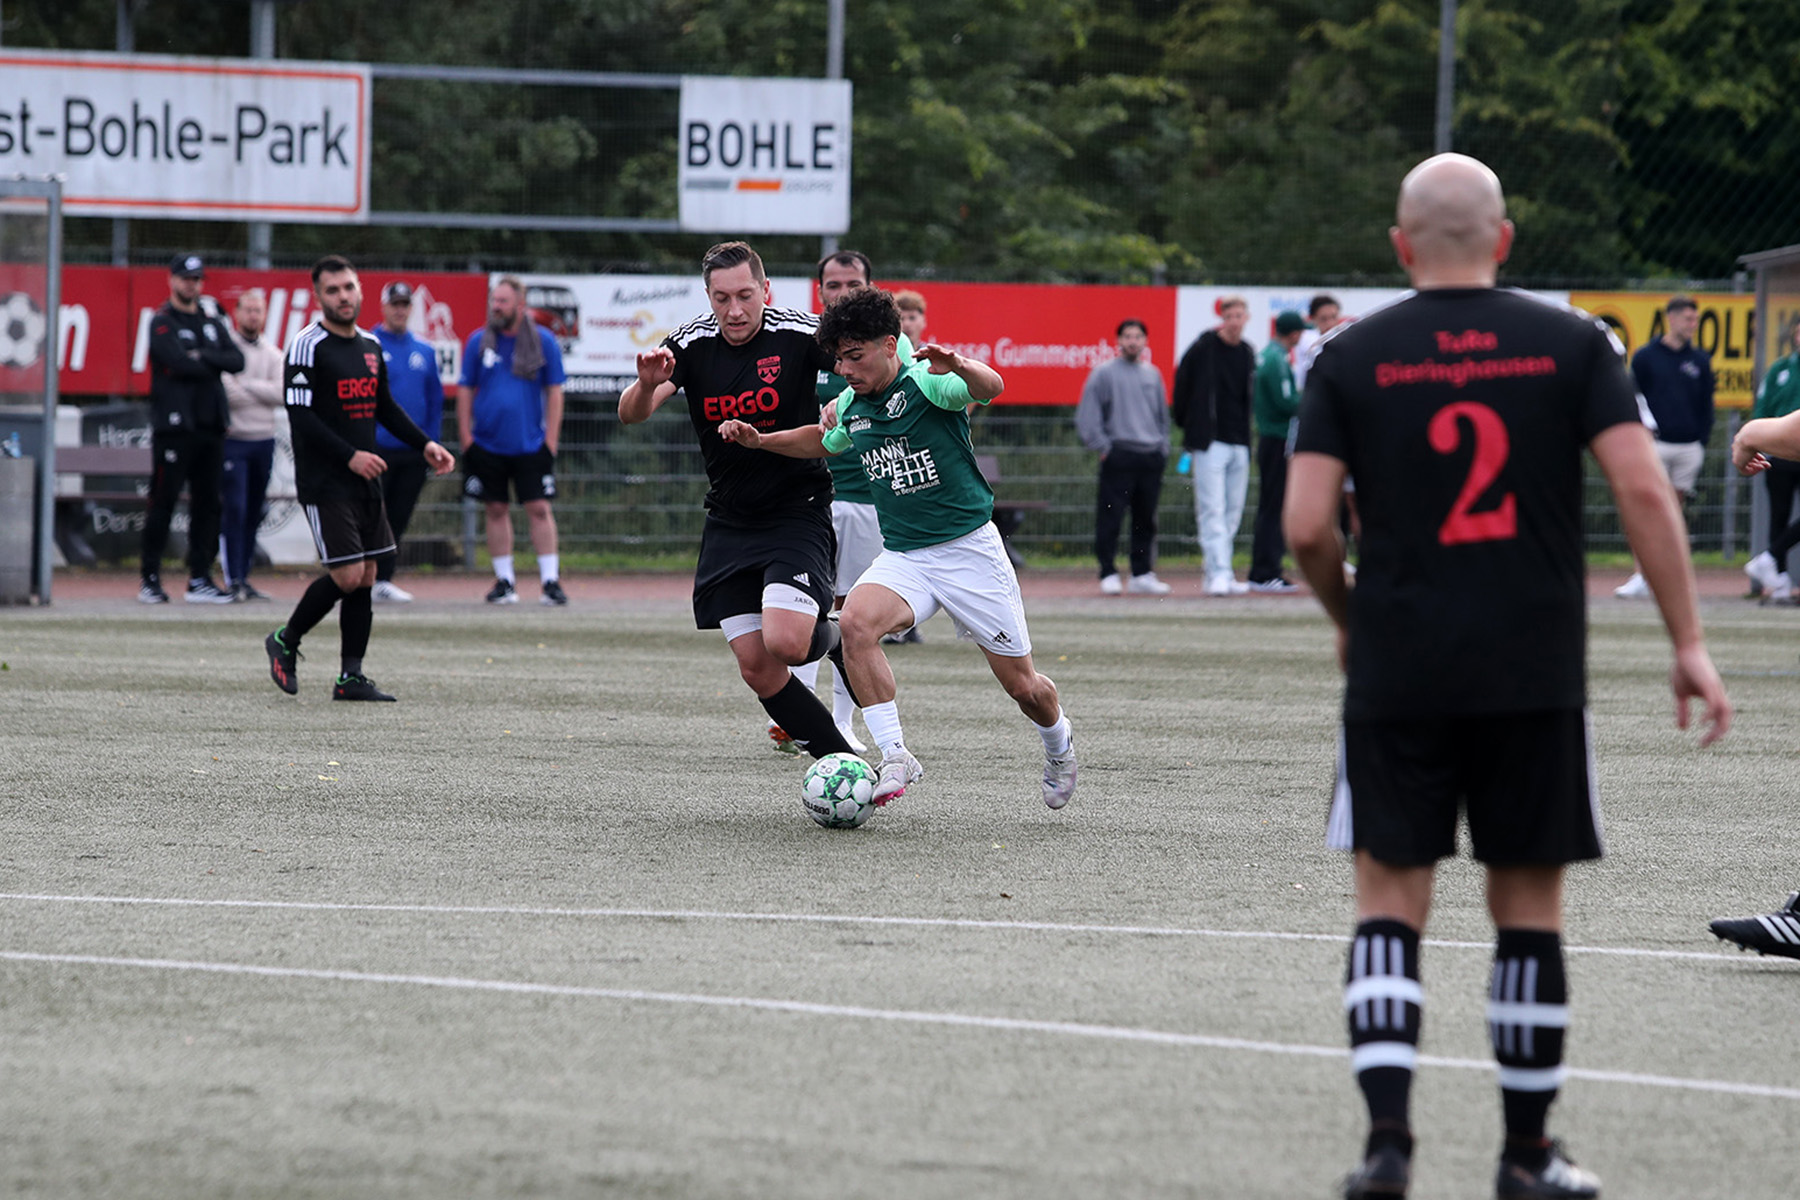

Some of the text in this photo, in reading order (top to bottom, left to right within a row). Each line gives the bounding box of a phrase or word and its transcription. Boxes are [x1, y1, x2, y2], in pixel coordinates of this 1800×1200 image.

[688, 123, 835, 169] BOHLE
[337, 377, 378, 399] ERGO
[1375, 357, 1556, 388] Dieringhausen
[704, 386, 780, 421] ERGO
[860, 442, 905, 466] MANN
[866, 449, 934, 481] SCHETTE
[1427, 401, 1518, 547] 2
[794, 596, 813, 606] JAKO
